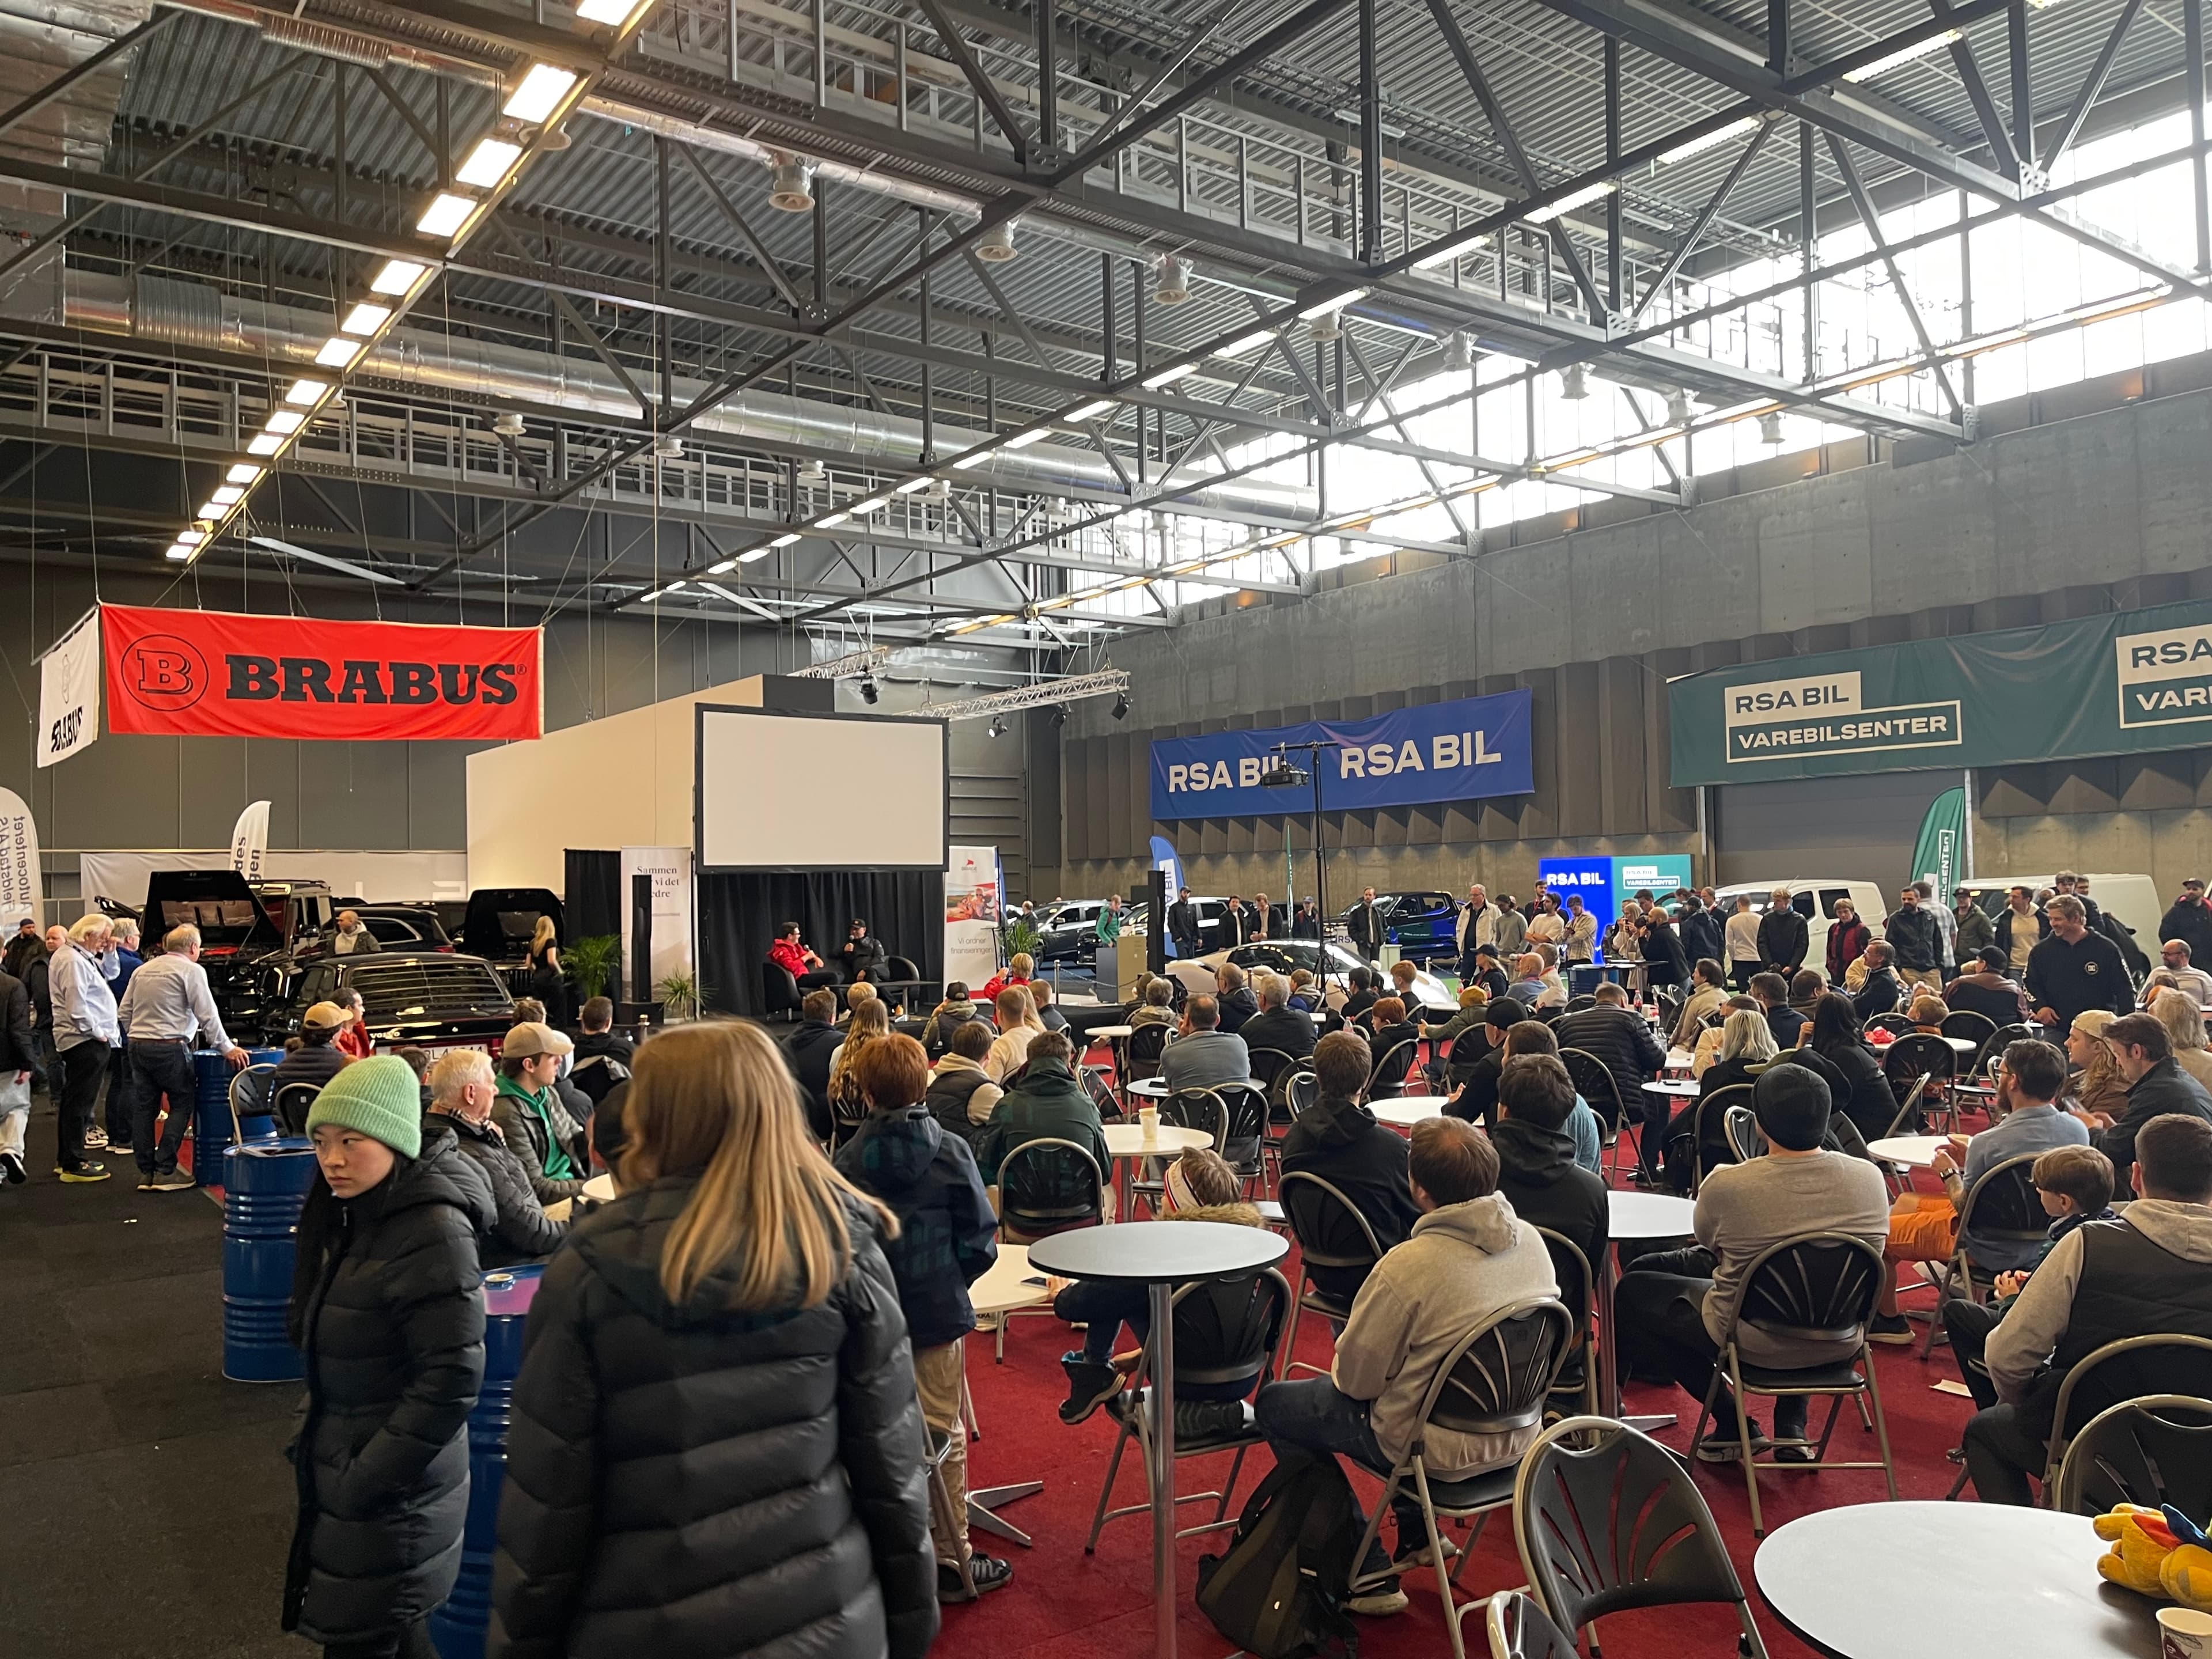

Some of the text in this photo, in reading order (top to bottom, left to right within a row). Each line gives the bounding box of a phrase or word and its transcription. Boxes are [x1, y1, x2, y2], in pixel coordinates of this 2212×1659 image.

[2131, 638, 2212, 668] RSA
[1736, 685, 1849, 714] RSA BIL
[1738, 715, 1947, 749] VAREBILSENTER
[1340, 730, 1502, 779] RSA BIL
[1169, 760, 1233, 793] RSA
[637, 866, 677, 874] Sammen
[1547, 872, 1605, 885] RSA BIL
